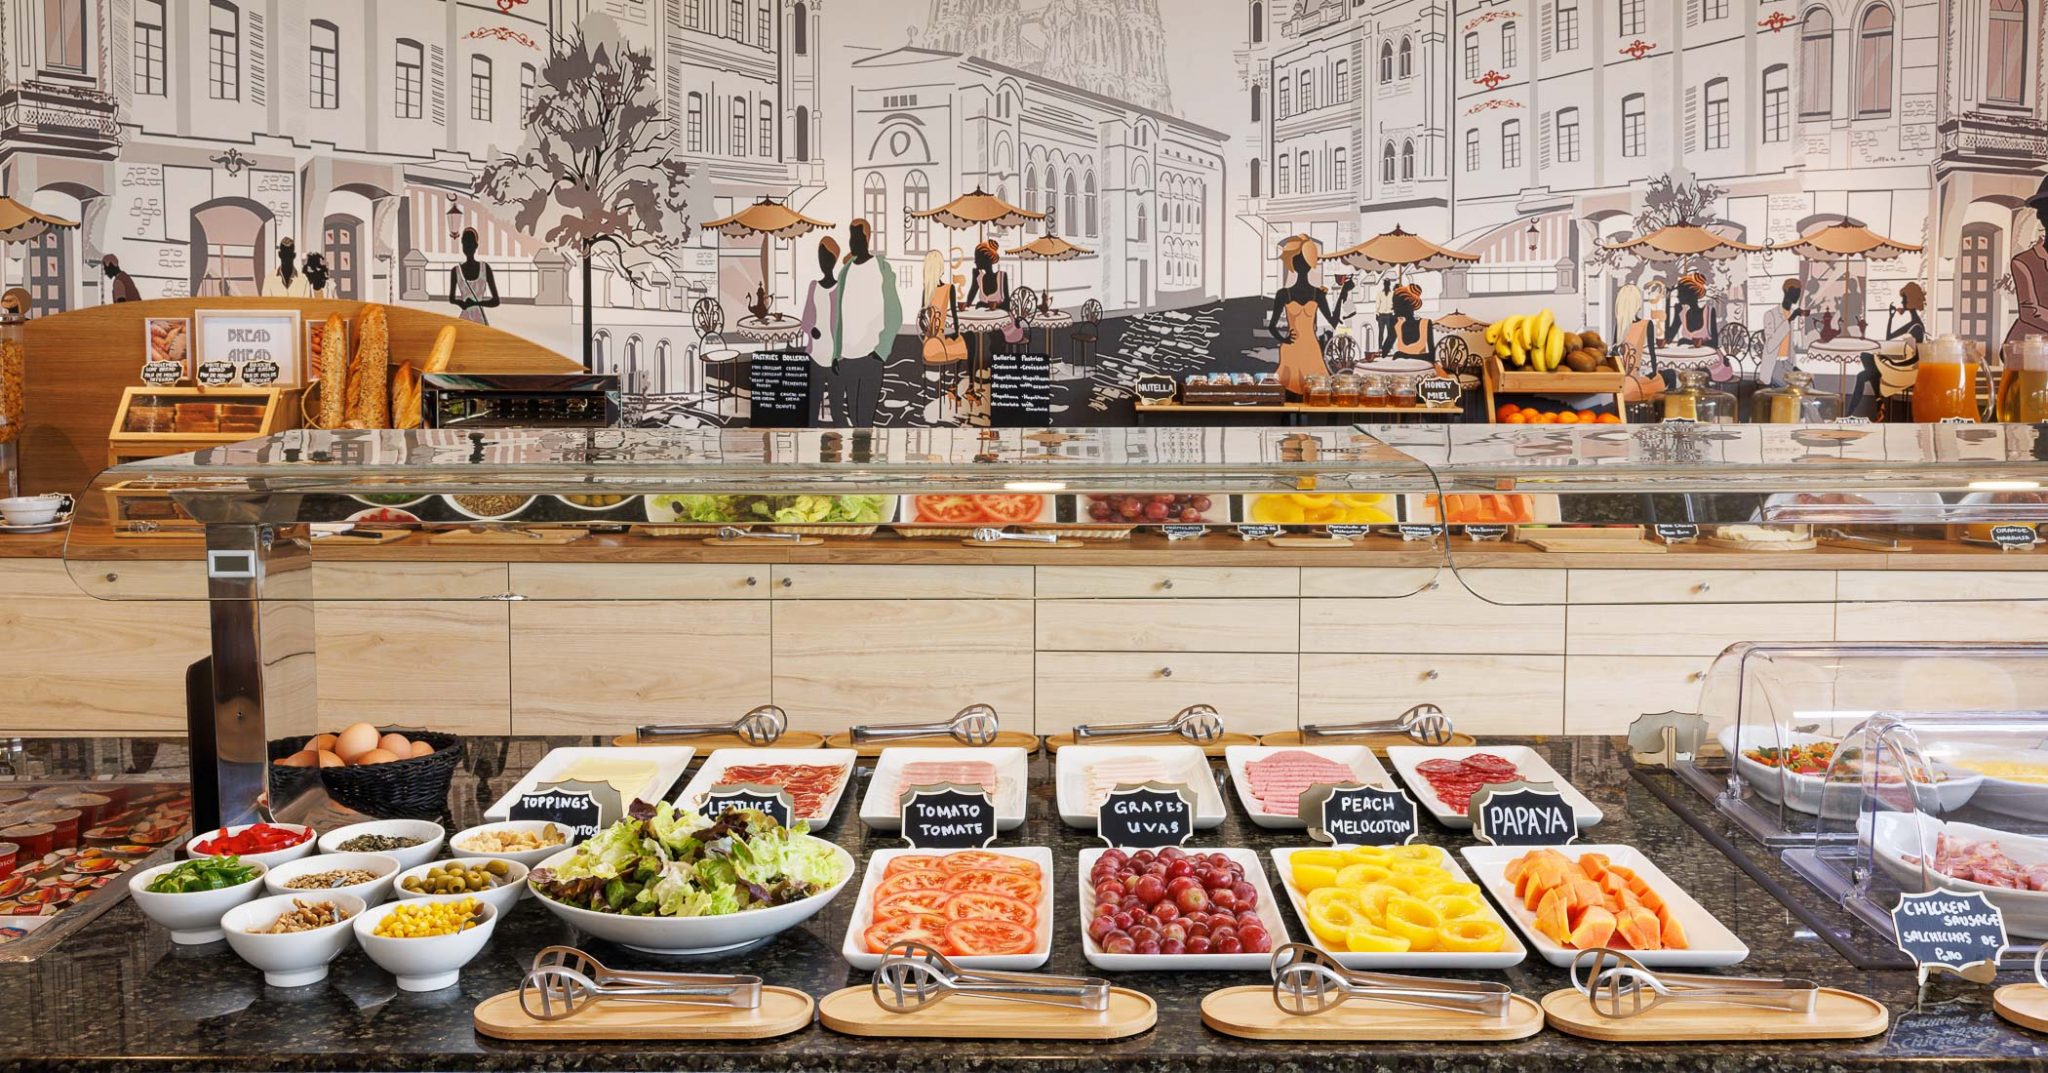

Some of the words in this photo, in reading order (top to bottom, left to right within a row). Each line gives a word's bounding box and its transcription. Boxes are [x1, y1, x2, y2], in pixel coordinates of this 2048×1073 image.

[228, 328, 270, 342] BREAD
[1138, 384, 1174, 392] NUTELLA
[522, 796, 589, 810] TOPPINGS
[1114, 801, 1183, 814] GRAPES
[1342, 796, 1394, 812] PEACH
[916, 804, 980, 819] TOMATO
[1127, 821, 1179, 834] UVAS
[1330, 819, 1410, 834] MELOCOTON
[1491, 806, 1568, 836] PAPAYA
[919, 823, 983, 836] TOMATE
[1904, 900, 1970, 916] CHICKEN
[1944, 914, 2000, 927] SAUSAGE
[1904, 930, 1972, 944] SALCHICHAS
[1981, 935, 1999, 948] DE
